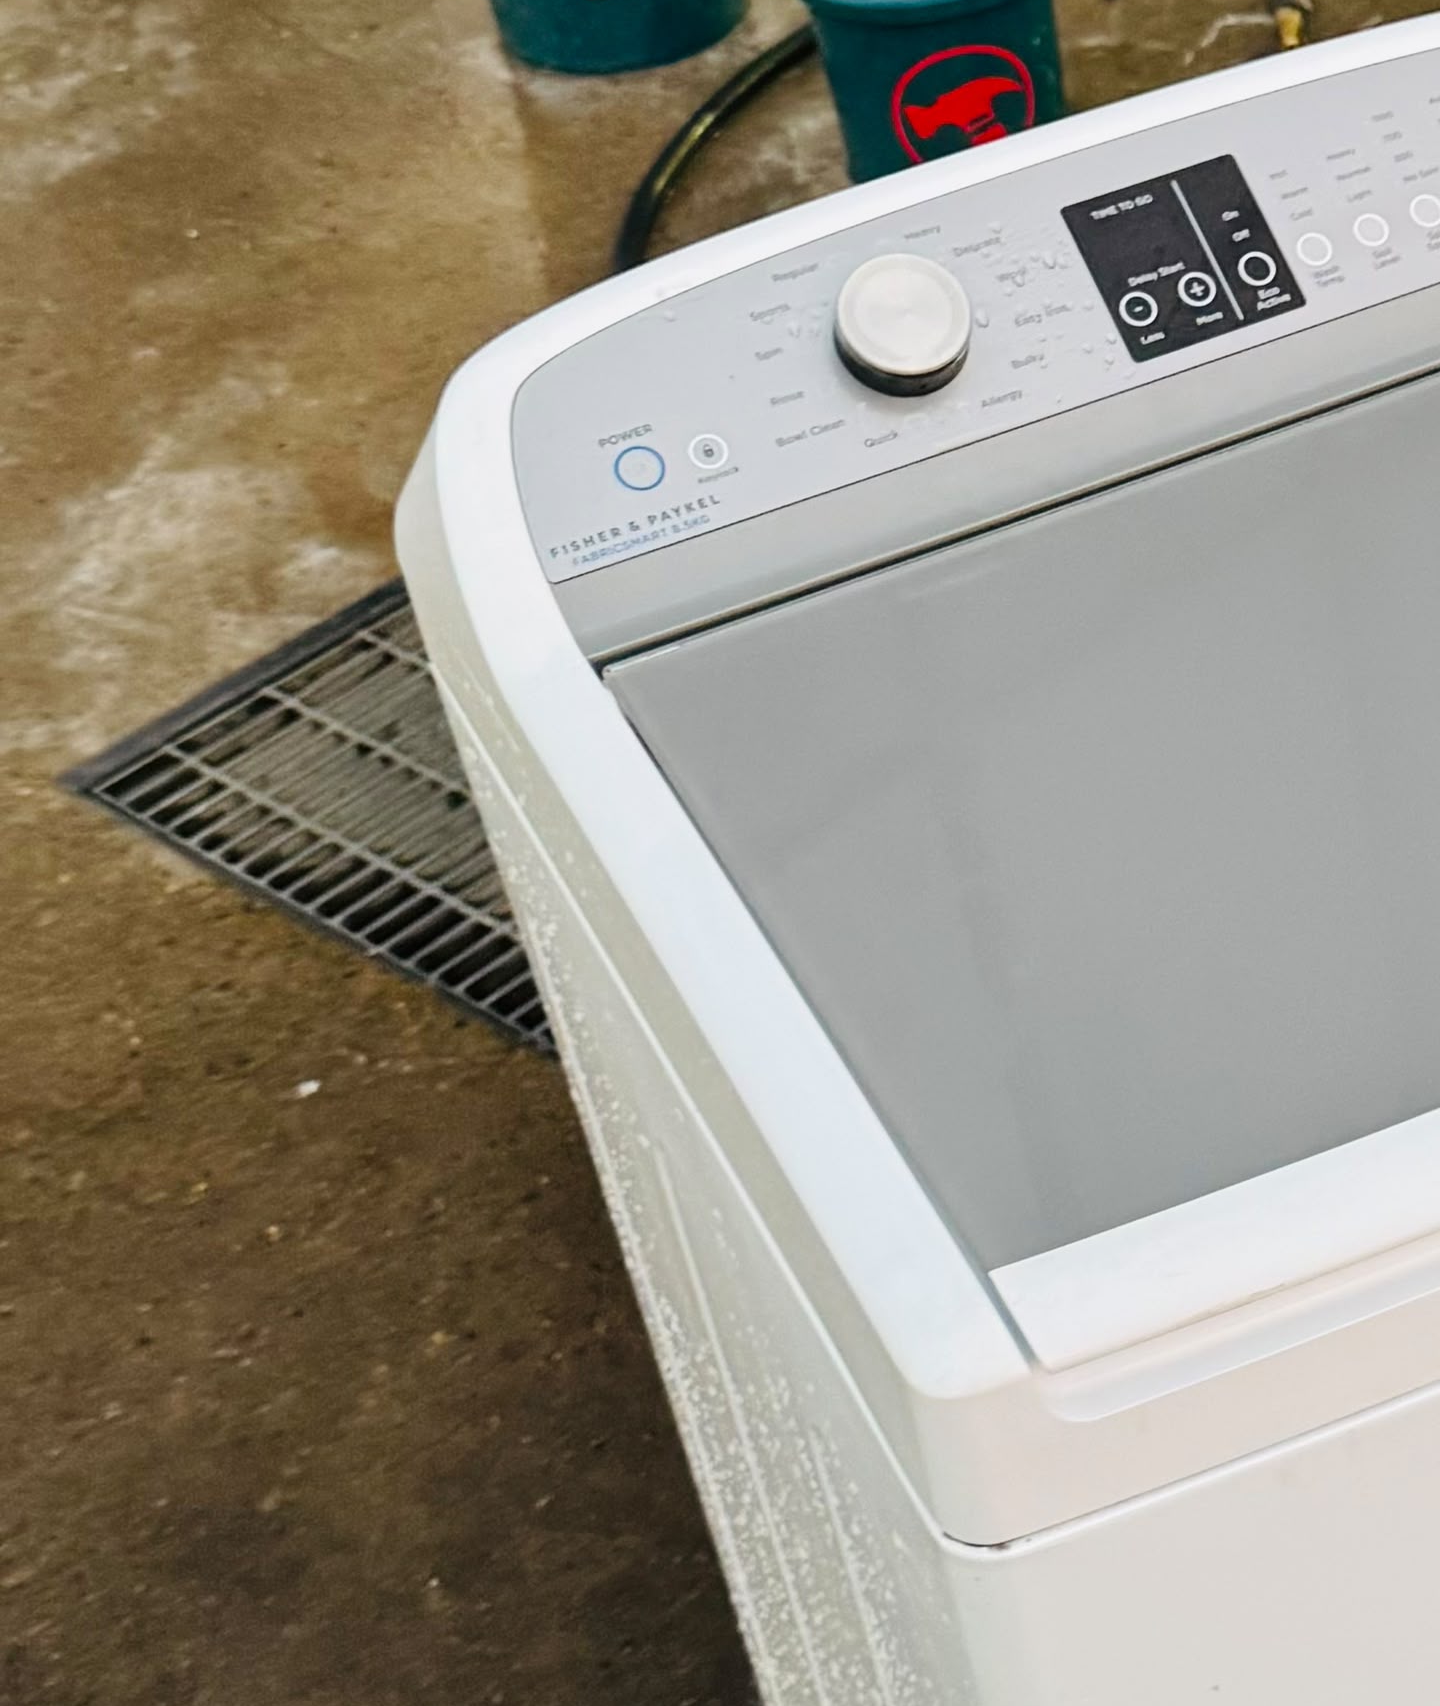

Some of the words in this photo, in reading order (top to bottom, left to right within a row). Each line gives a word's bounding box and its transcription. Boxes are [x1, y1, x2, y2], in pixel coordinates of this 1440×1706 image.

[771, 262, 819, 282] Regular
[598, 424, 653, 448] POWER
[550, 527, 622, 558] FISHER
[628, 520, 641, 532] &
[648, 494, 721, 526] PAYKEL
